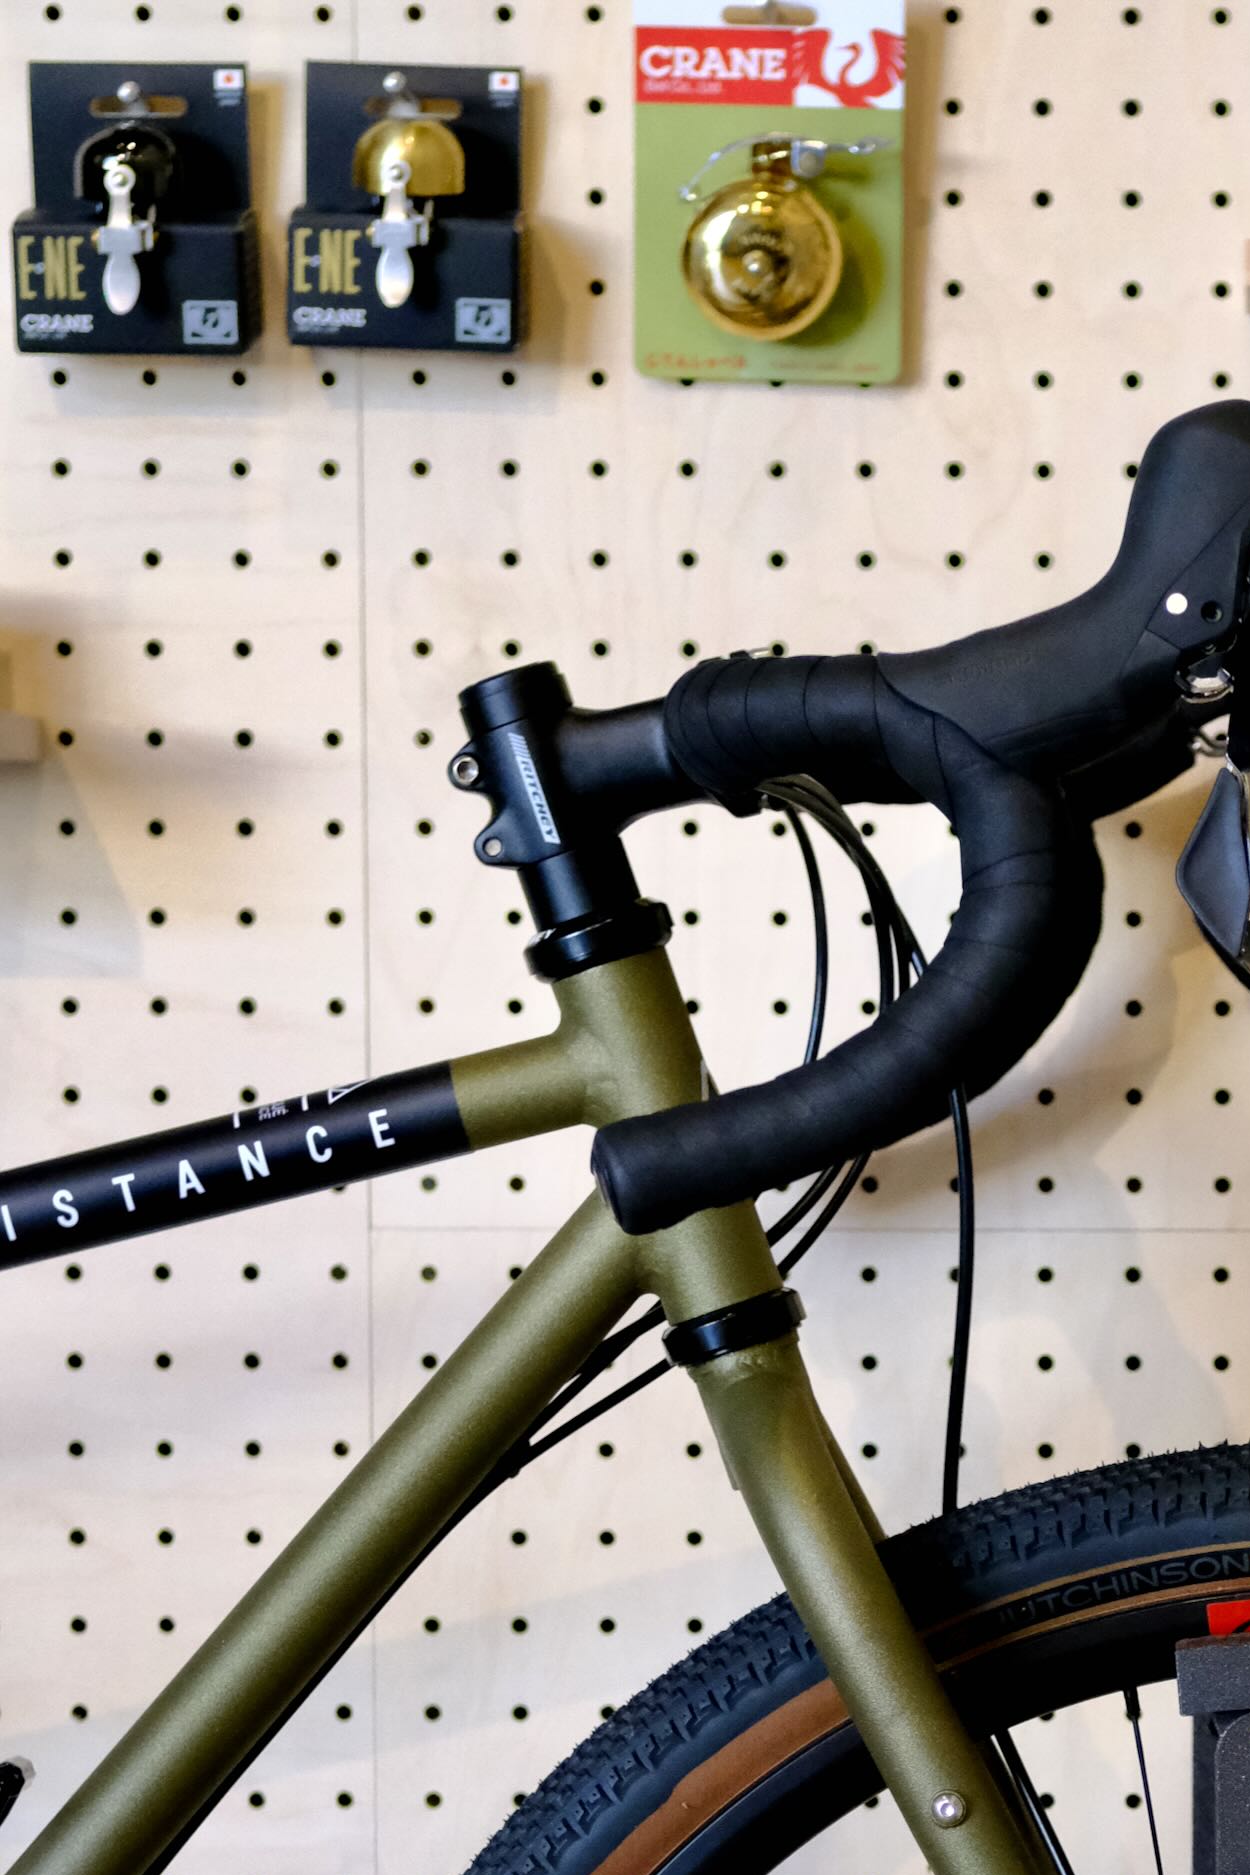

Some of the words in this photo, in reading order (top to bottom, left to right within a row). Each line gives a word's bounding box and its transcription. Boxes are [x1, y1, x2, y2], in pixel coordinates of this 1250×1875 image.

[639, 45, 787, 80] CRANE
[20, 313, 94, 333] CRANE
[292, 306, 368, 327] CRANE
[520, 757, 558, 842] RITCHEY
[0, 1108, 396, 1242] ISTANCE
